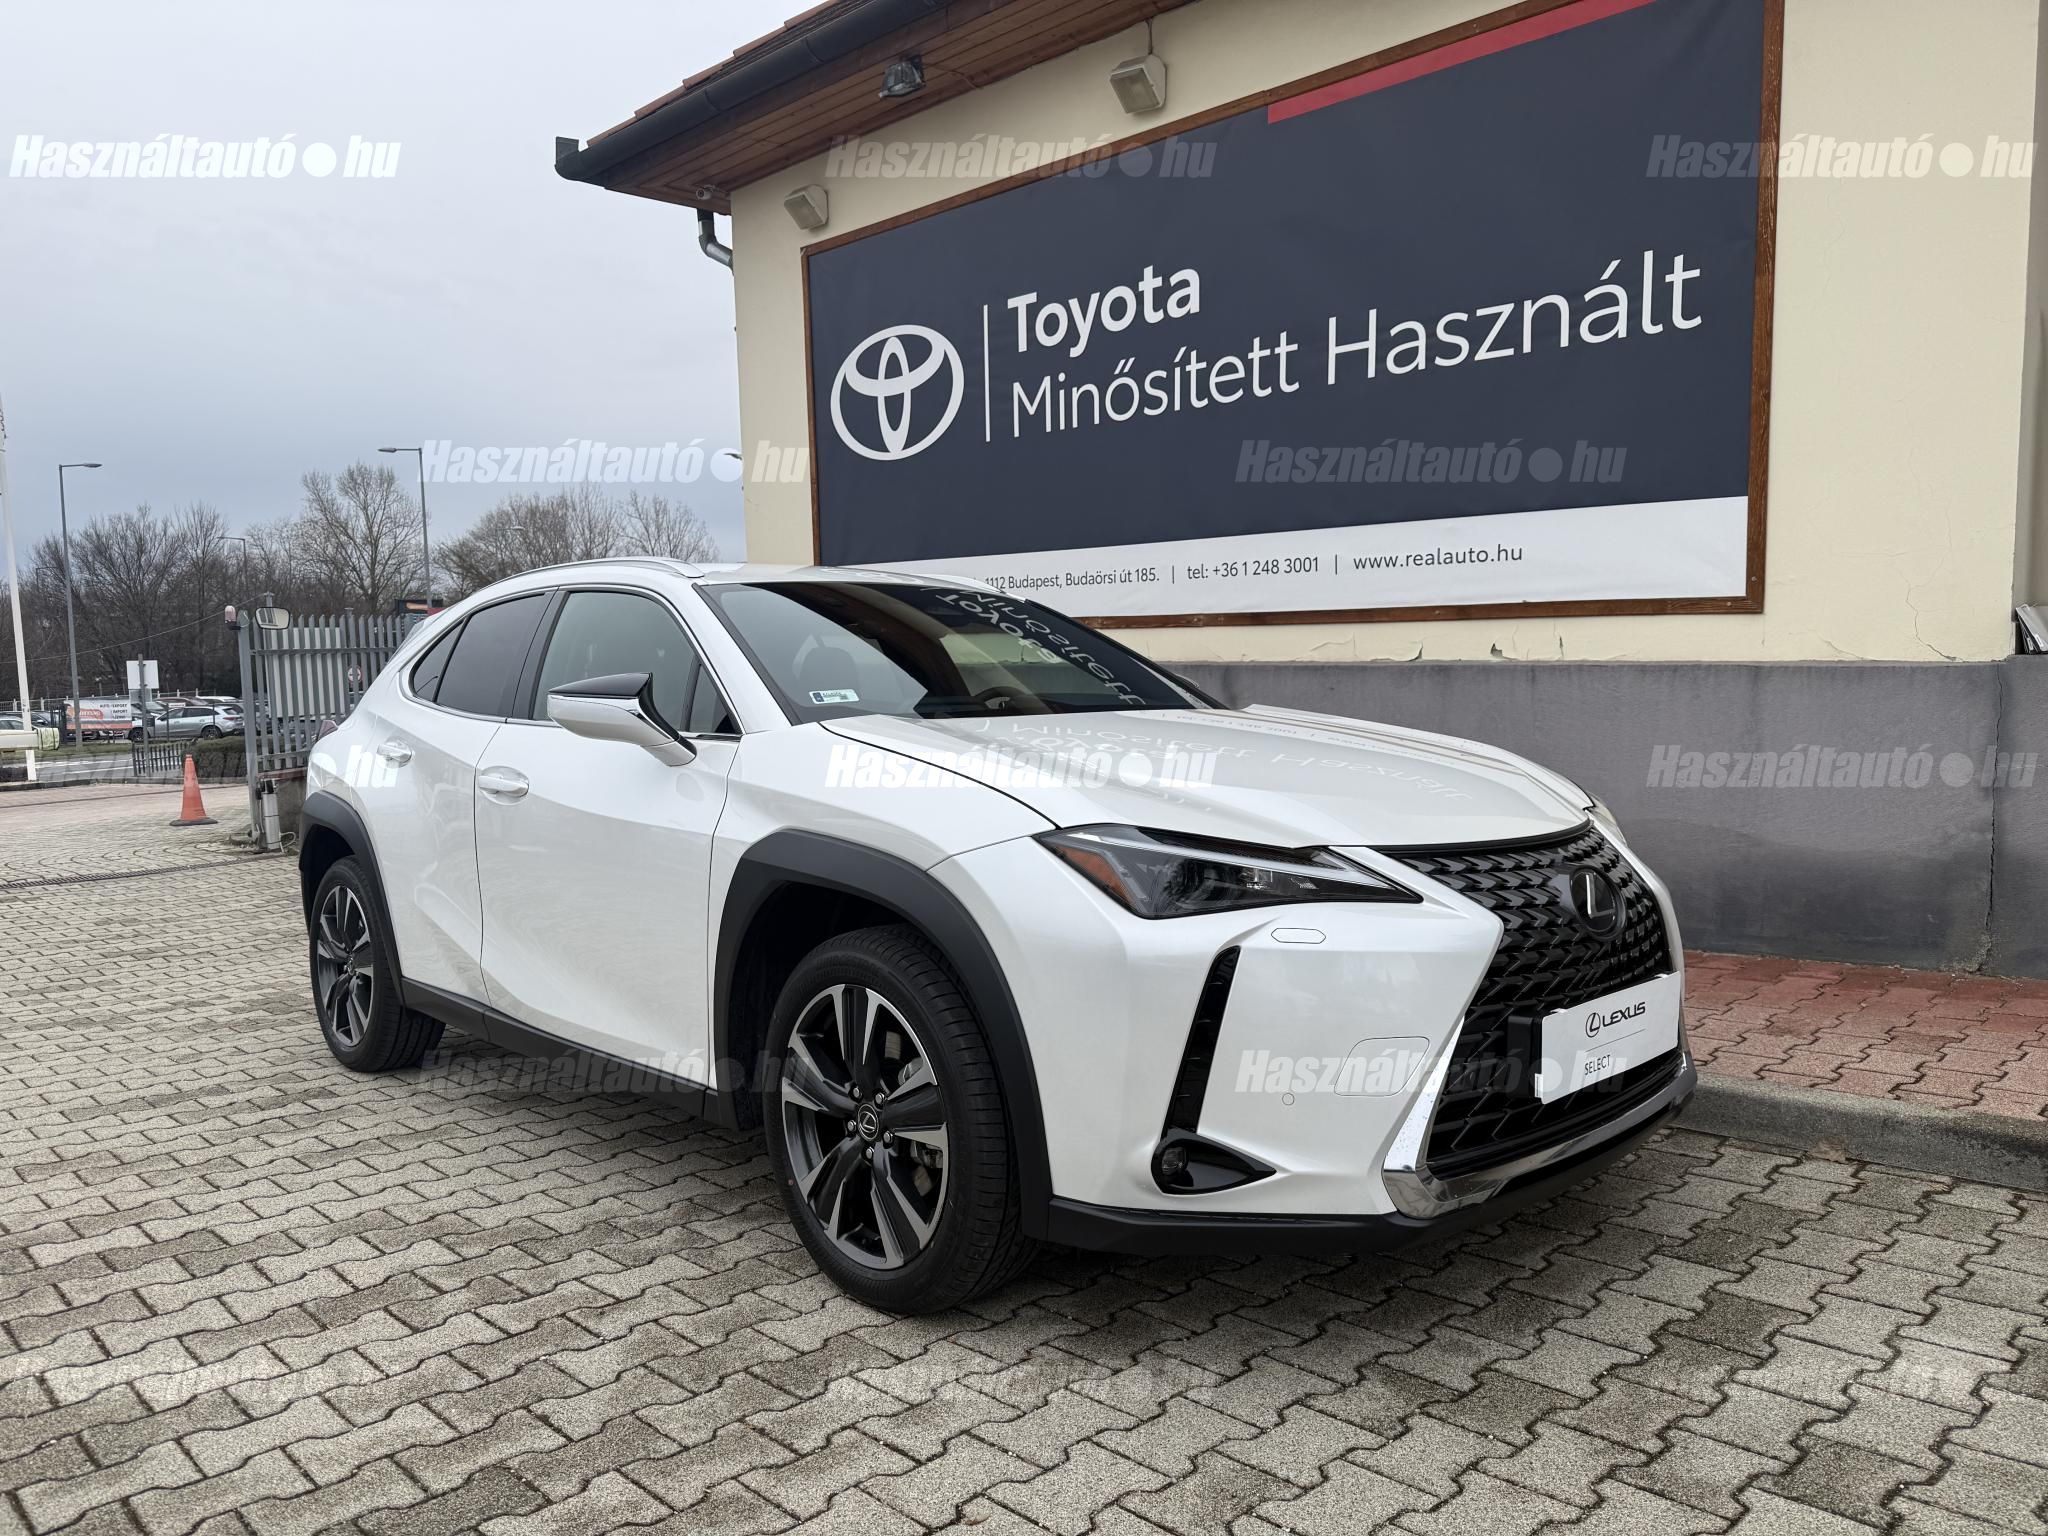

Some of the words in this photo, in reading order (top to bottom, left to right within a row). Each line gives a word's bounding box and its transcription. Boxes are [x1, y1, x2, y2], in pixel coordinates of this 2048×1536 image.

[1007, 265, 1202, 359] Toyota
[1012, 330, 1300, 438] Minősített
[1326, 248, 1703, 386] Használt
[1186, 563, 1209, 580] tel:
[1252, 559, 1280, 576] 248
[1283, 556, 1319, 574] 3001
[1353, 543, 1523, 571] www.realauto.hu
[1008, 574, 1063, 591] Budapest,
[1065, 569, 1117, 586] Budaörsi
[1119, 568, 1133, 584] út
[1135, 567, 1160, 583] 185.
[1602, 1001, 1646, 1028] LEXUS
[1584, 1054, 1611, 1076] SELECT
